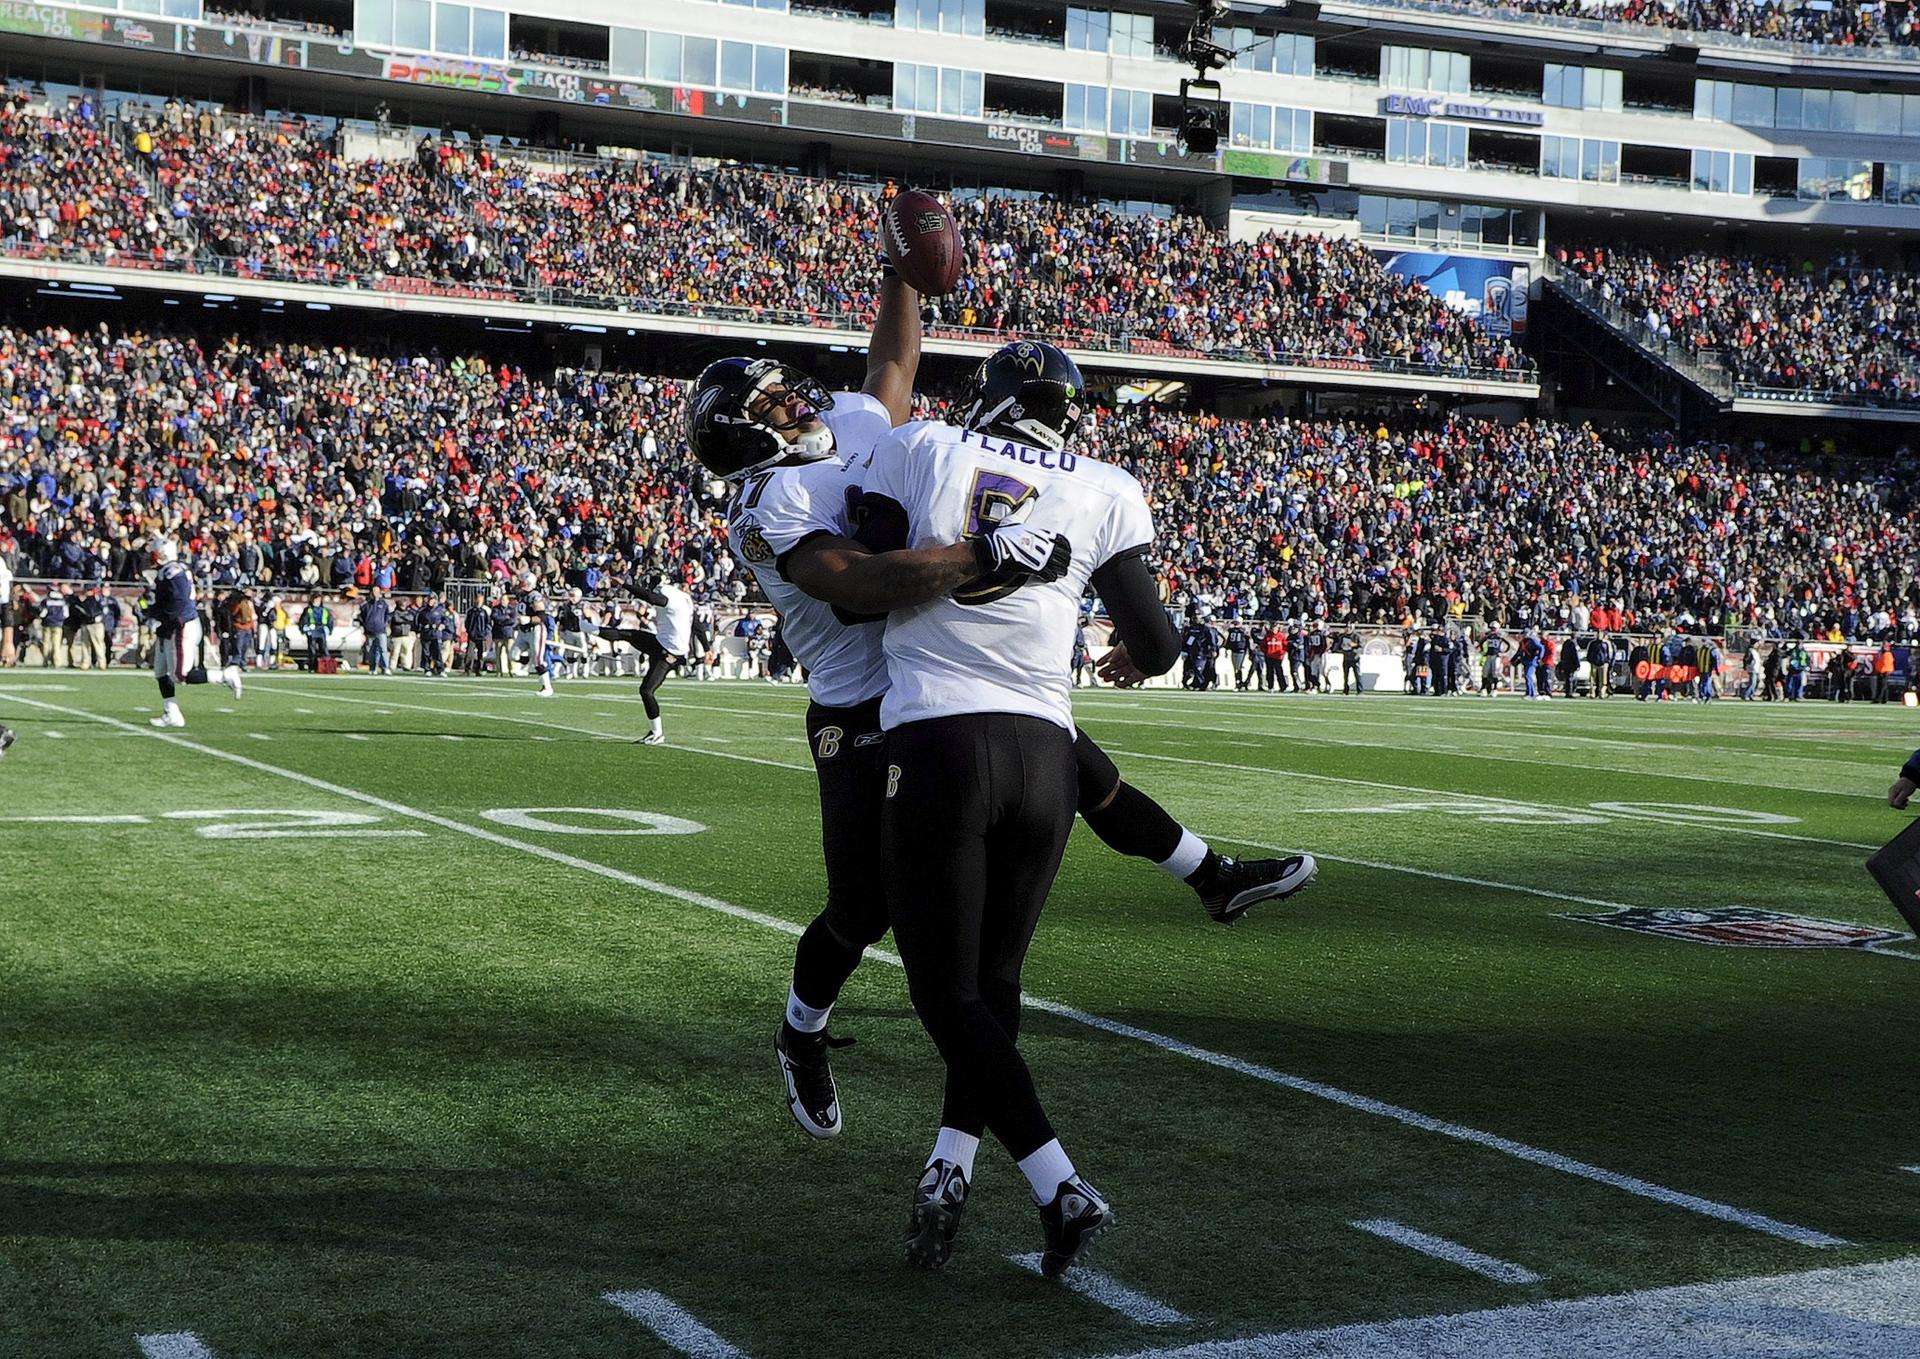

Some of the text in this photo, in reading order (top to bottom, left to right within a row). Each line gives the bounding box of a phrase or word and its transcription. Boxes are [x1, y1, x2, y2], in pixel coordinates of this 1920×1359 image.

[523, 69, 580, 90] REACH
[558, 87, 586, 102] FOR
[1386, 94, 1440, 116] EMC
[987, 125, 1039, 144] REACH
[1019, 140, 1043, 153] FOR
[1029, 424, 1060, 448] RAVENS
[1057, 418, 1070, 434] 5
[961, 429, 1077, 472] FLACCO
[814, 726, 843, 757] B
[886, 764, 902, 797] B
